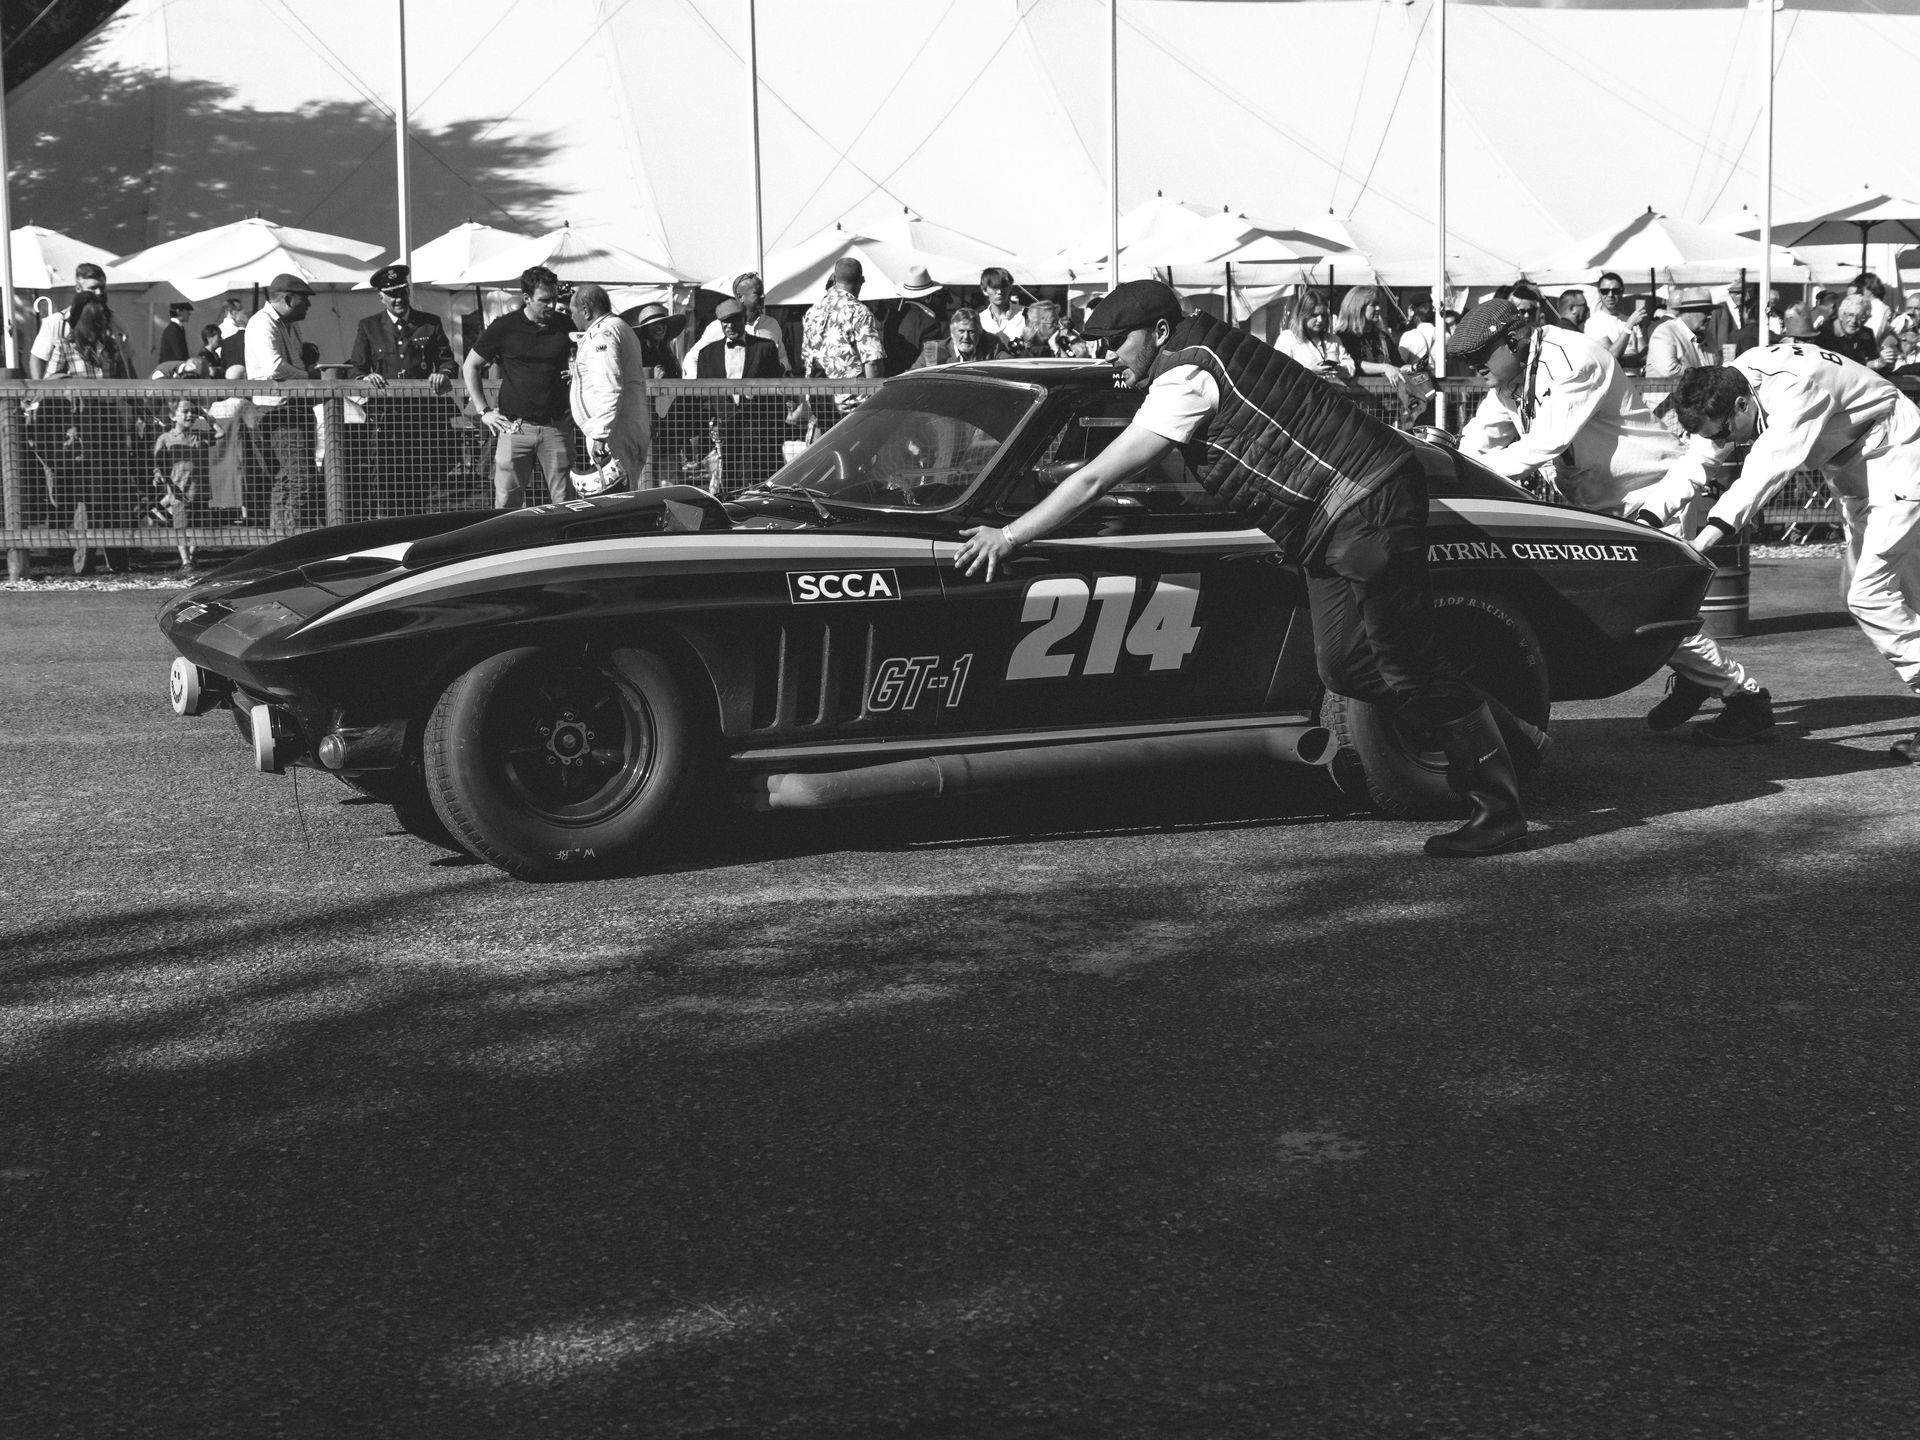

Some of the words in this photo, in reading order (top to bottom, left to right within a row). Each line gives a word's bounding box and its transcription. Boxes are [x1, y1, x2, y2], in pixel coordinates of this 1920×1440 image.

[1512, 543, 1640, 562] CHEVROLET
[797, 572, 893, 601] SCCA
[1005, 572, 1201, 681] 214
[867, 653, 974, 712] GT-1
